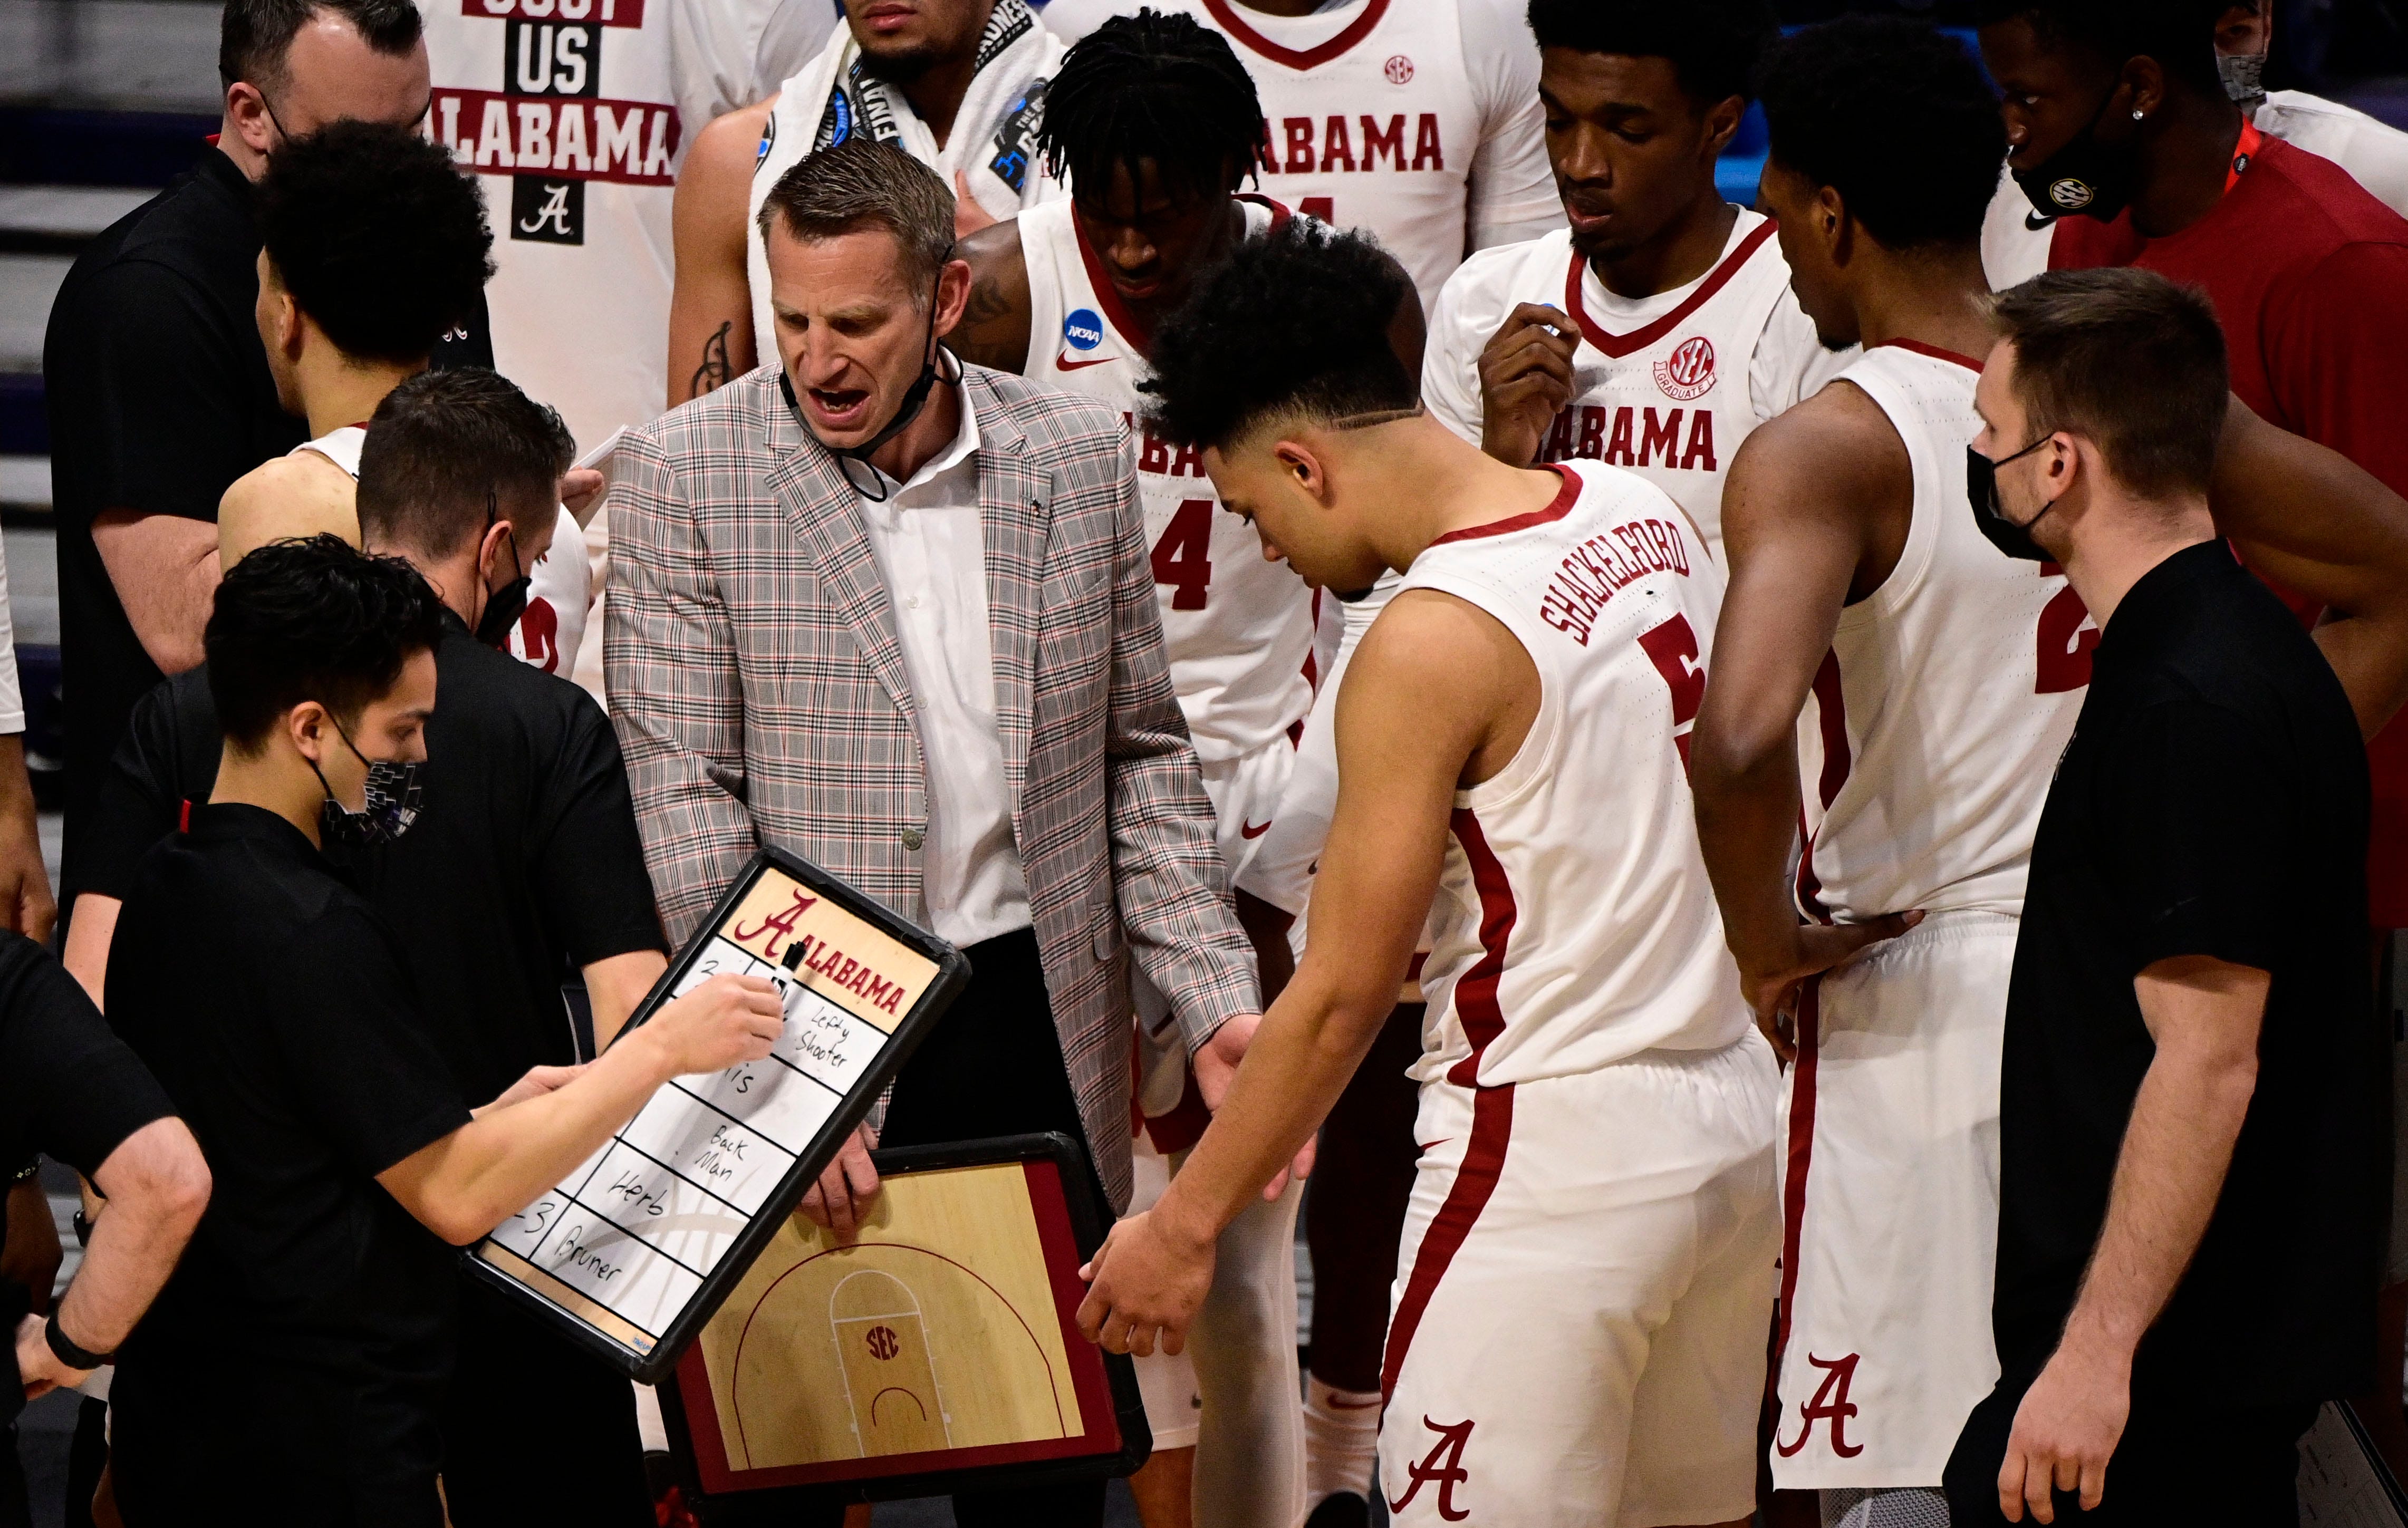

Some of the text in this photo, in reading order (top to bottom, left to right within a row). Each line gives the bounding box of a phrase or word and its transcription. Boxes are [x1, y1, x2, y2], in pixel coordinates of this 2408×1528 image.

[517, 24, 588, 93] US
[520, 184, 571, 235] A
[1067, 325, 1100, 343] NCAA
[1671, 338, 1714, 385] SEC
[1656, 373, 1705, 399] GRADUATE
[1531, 404, 1717, 471] ABAMA
[1150, 500, 1213, 611] 4
[1540, 519, 1690, 647] SHACKELFORD
[811, 1006, 850, 1043] Lefty
[795, 1030, 848, 1069] Shooter
[710, 1124, 749, 1160] Back
[694, 1151, 734, 1182] Man
[608, 1169, 664, 1217] Herb
[554, 1225, 623, 1282] Bruner
[865, 1325, 899, 1361] SEC
